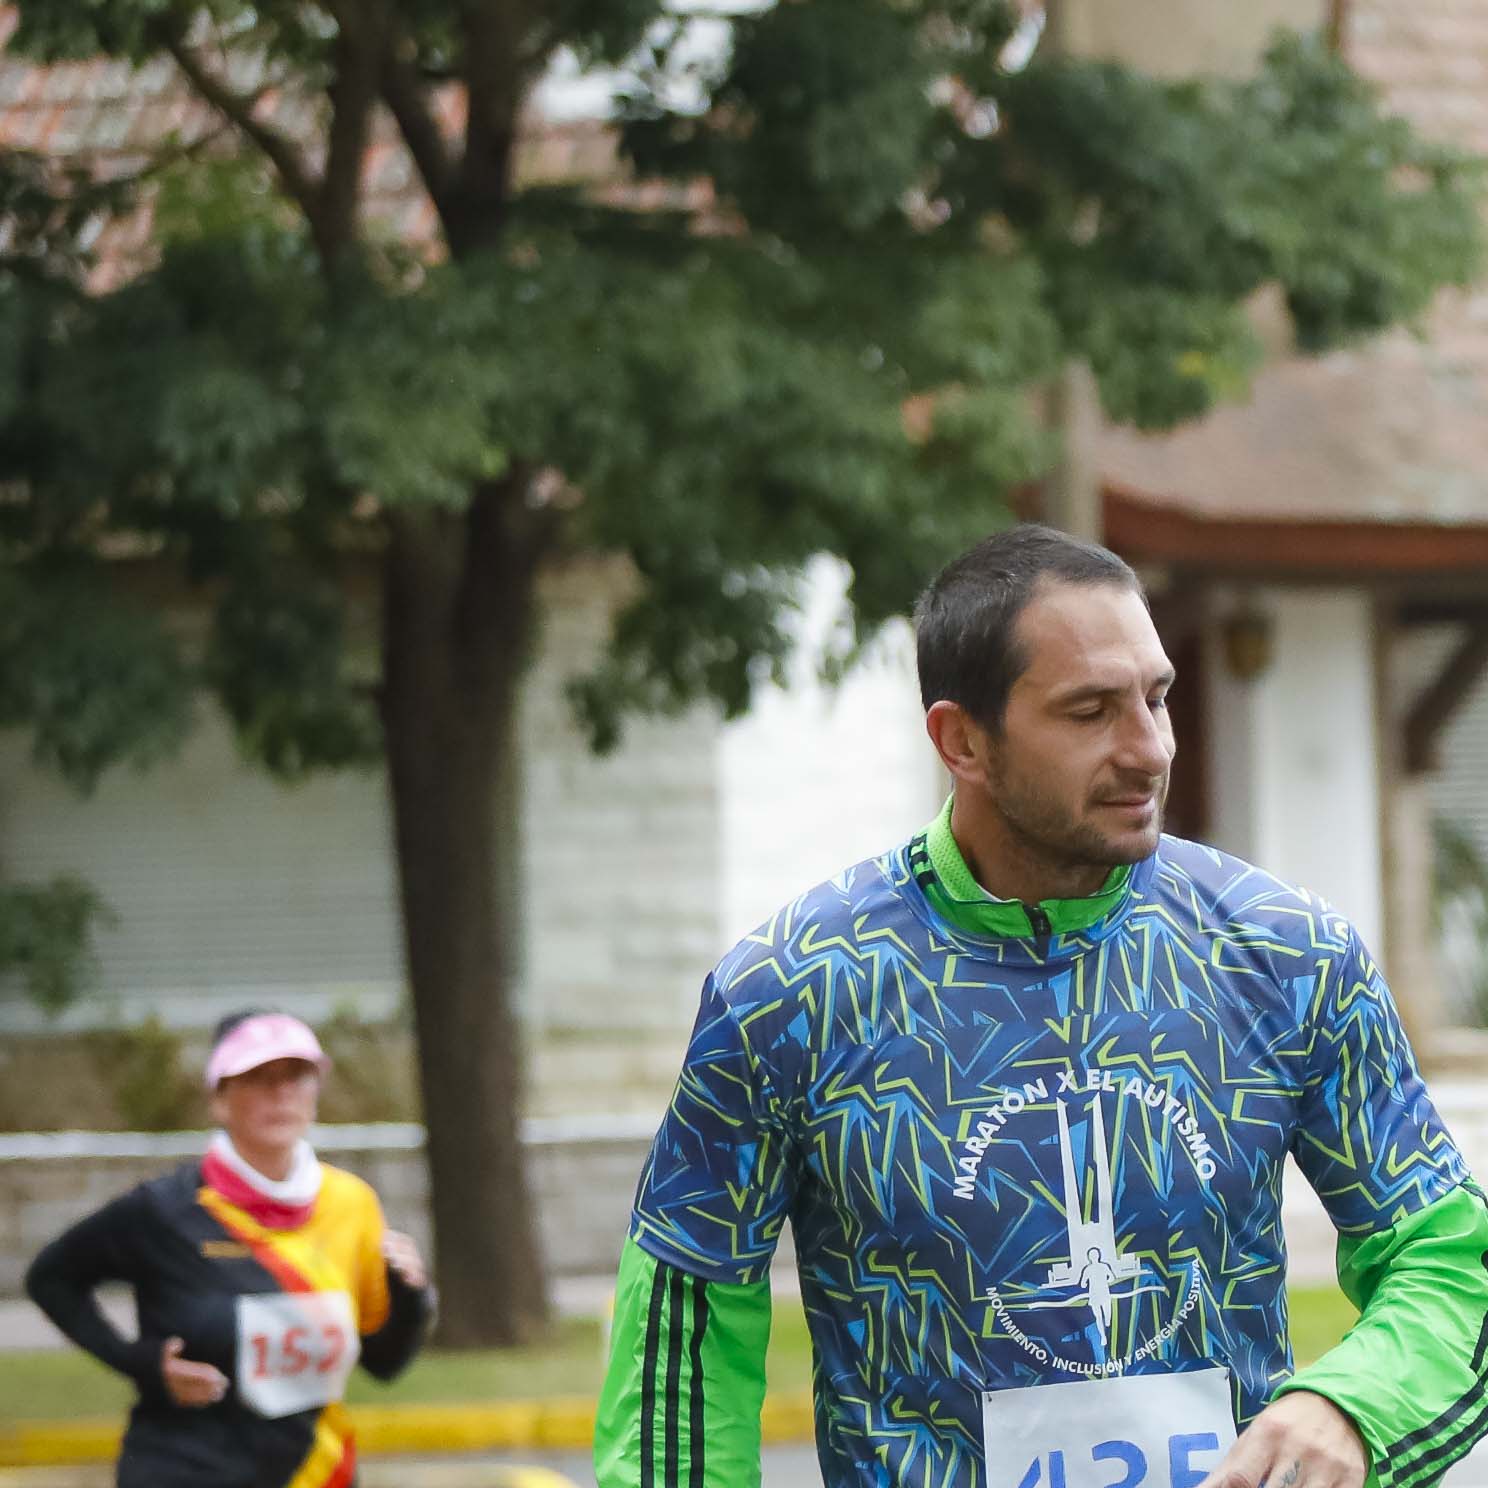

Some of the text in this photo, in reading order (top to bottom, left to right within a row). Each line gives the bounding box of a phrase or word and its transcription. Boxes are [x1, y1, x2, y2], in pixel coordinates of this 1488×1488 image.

[954, 1069, 1216, 1200] MARATÓN X EL AUTISMO
[986, 1287, 1048, 1364] MOVIMIENTO,
[1052, 1355, 1123, 1375] INCLUSIÓN
[1135, 1320, 1183, 1361] ENERGÍA
[1179, 1259, 1200, 1320] POSITIVA
